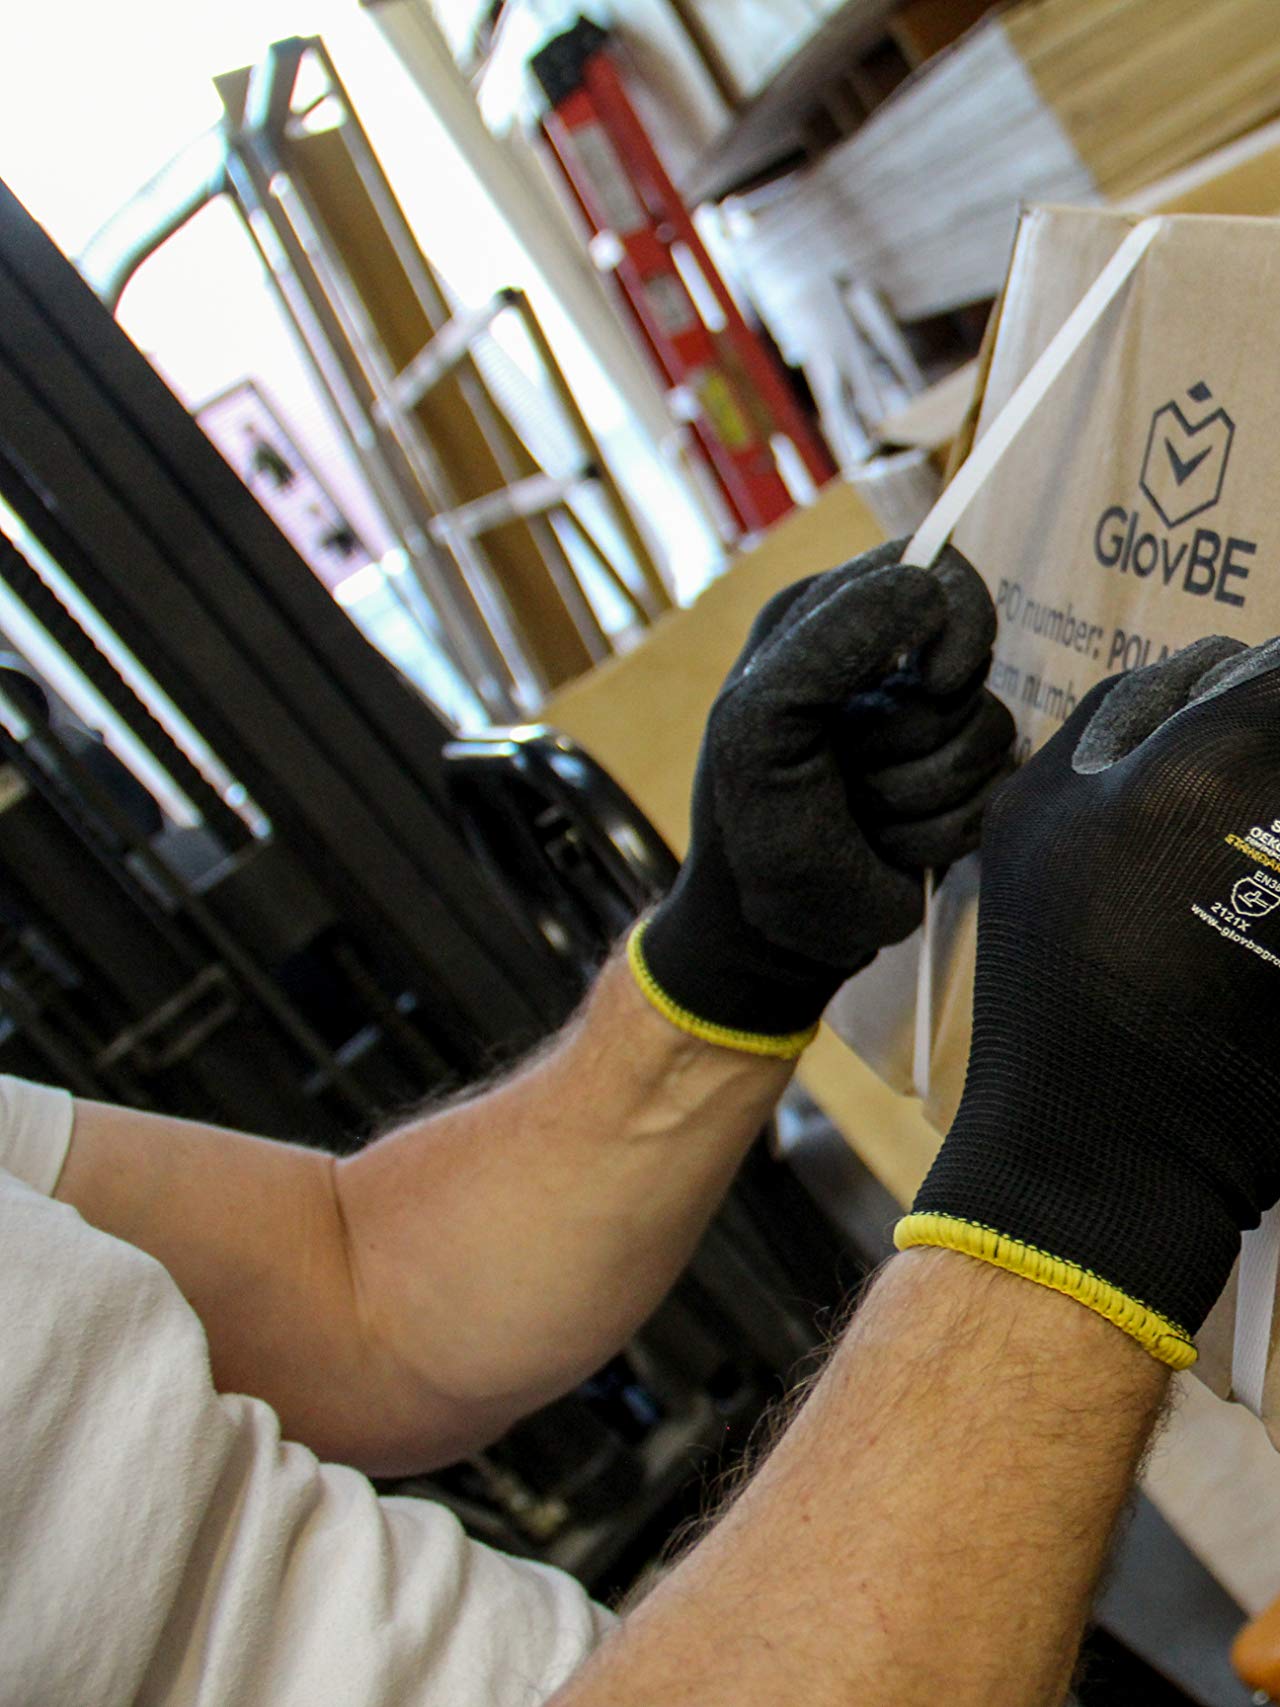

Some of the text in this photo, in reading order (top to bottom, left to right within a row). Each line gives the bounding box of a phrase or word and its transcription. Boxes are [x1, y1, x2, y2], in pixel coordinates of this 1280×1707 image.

[1093, 506, 1257, 608] GlovBE
[1022, 603, 1104, 660] number:
[1107, 628, 1186, 673] POLA
[1210, 901, 1251, 932] 2121X
